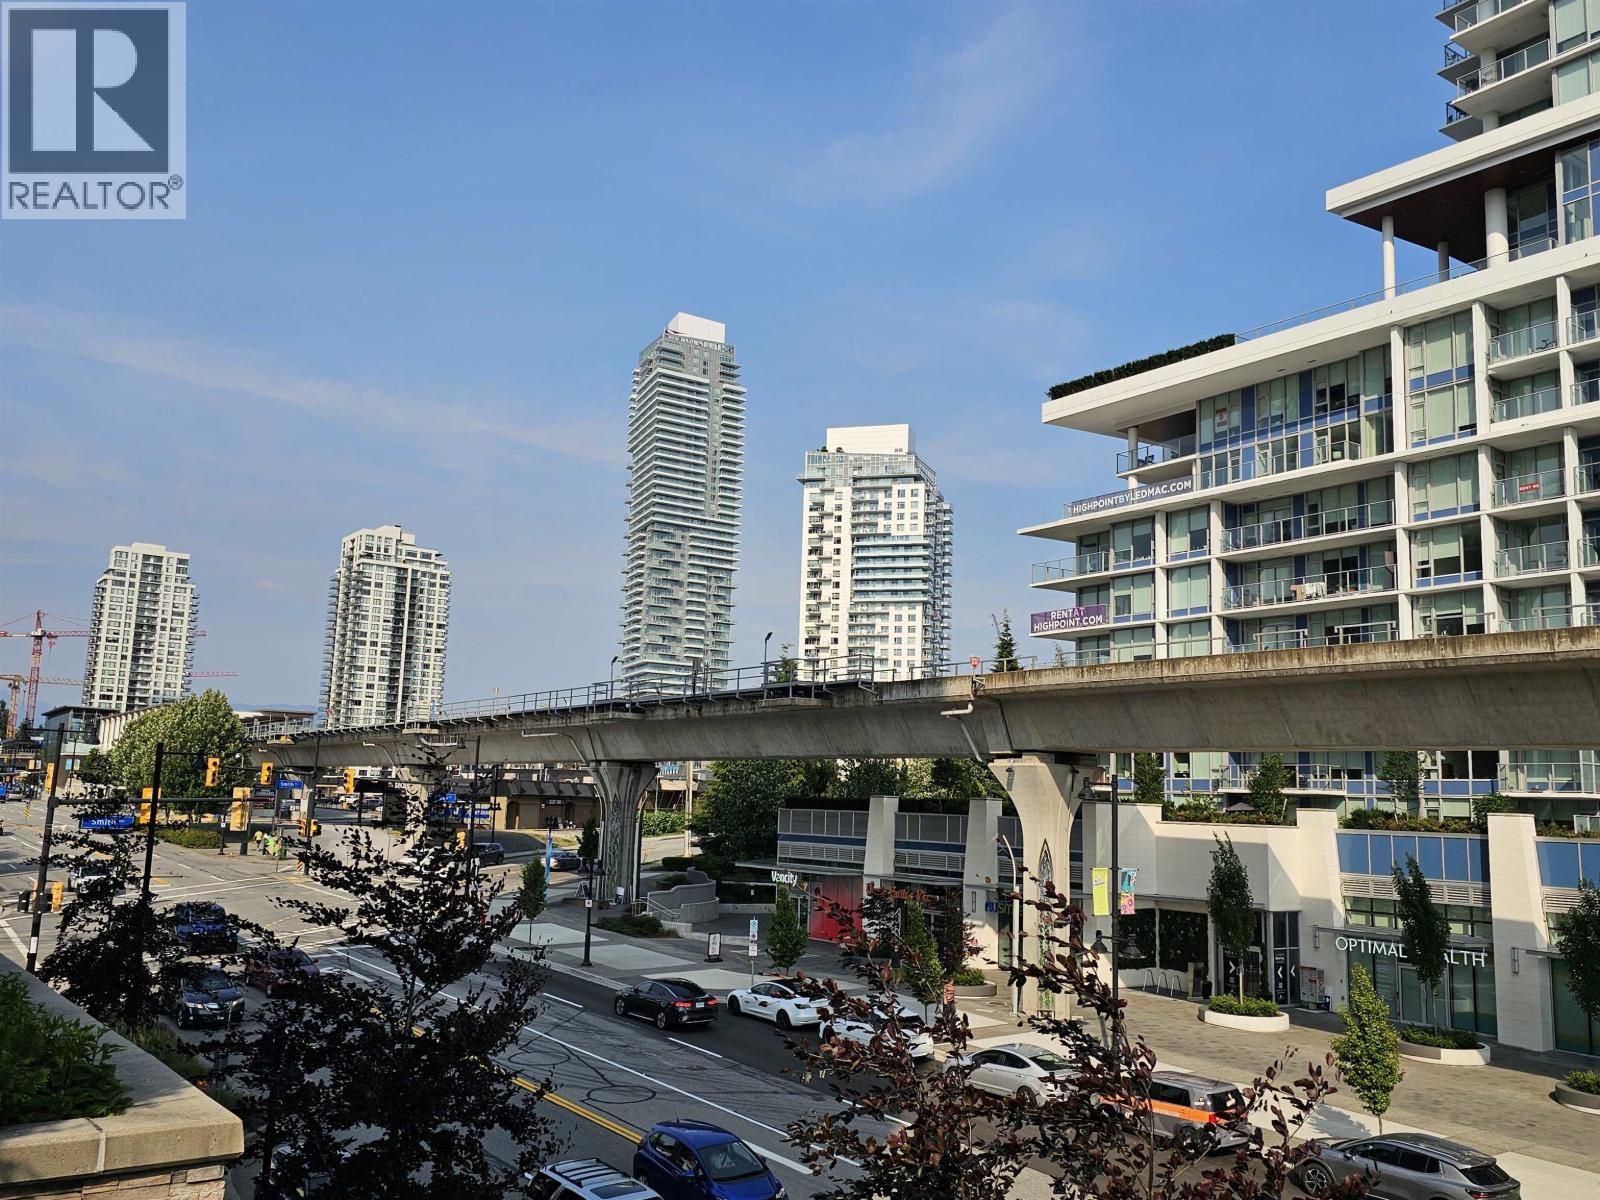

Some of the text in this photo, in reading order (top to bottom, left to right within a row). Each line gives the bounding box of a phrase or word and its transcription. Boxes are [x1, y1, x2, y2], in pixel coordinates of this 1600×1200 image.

[1073, 480, 1192, 514] HIGHPOINTBYLEDMAC.COM
[1034, 615, 1103, 632] HIGHPOINT.COM
[91, 818, 117, 826] Smith
[771, 870, 798, 887] Vancity
[1335, 937, 1408, 959] OPTIMAL
